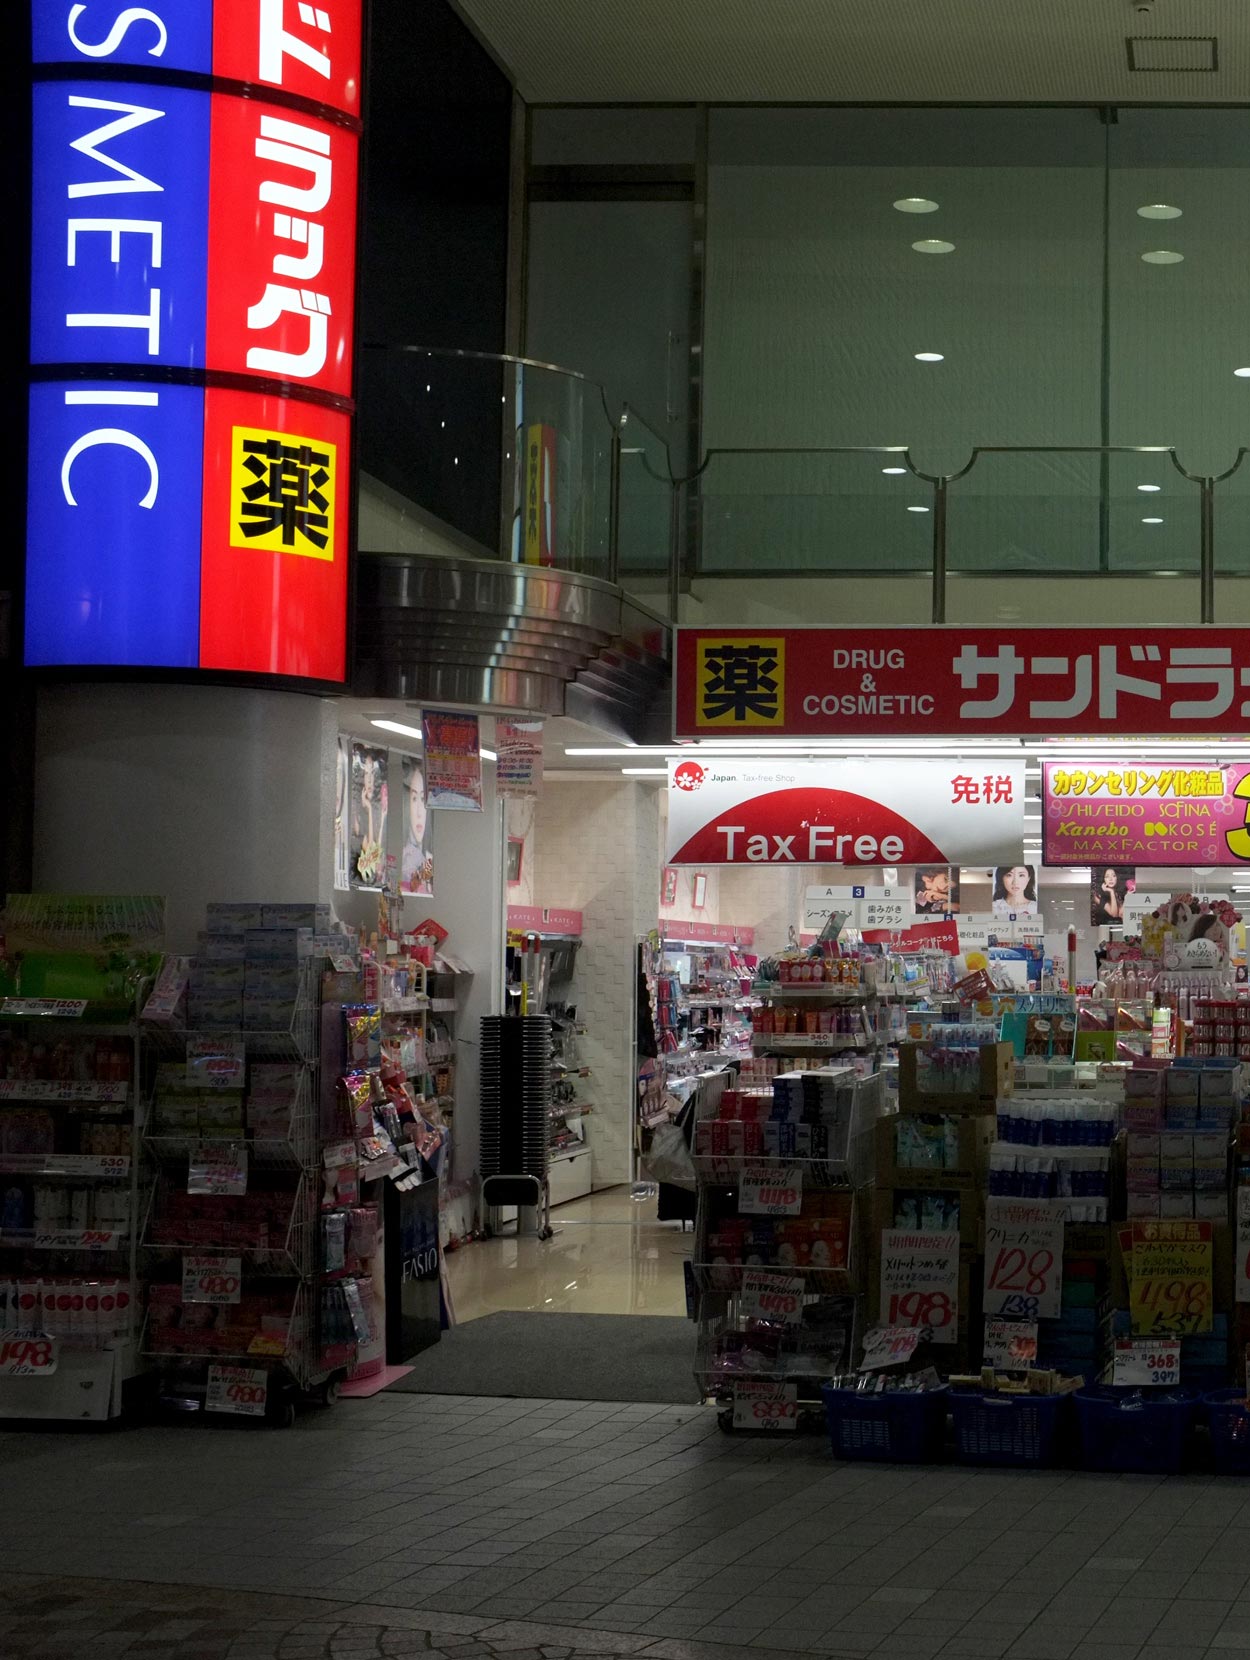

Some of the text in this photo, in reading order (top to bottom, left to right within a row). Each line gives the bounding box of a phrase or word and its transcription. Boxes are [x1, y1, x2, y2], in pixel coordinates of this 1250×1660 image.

[240, 438, 330, 551] 薬
[832, 649, 906, 670] DRUG
[702, 644, 779, 721] 薬
[860, 672, 878, 693] &
[802, 694, 935, 716] COSMETIC
[775, 774, 796, 784] Shop
[950, 774, 1014, 805] 免税
[1053, 768, 1224, 797] カウンセリング化粧品
[1064, 801, 1211, 819] SHISEIDO SOFINA
[1056, 821, 1217, 838] Kanebo KOSÉ
[716, 825, 905, 862] Tax Free
[826, 888, 832, 896] A
[1144, 896, 1151, 904] A
[867, 905, 902, 913] 歯みがき
[867, 915, 903, 925] 歯ブラシ
[100, 1158, 124, 1167] 530
[402, 1247, 438, 1284] FASIO
[988, 1247, 1054, 1296] 128
[1139, 1280, 1208, 1316] 498
[889, 1291, 952, 1328] 198
[1147, 1354, 1176, 1369] 368
[1151, 1371, 1176, 1383] 397
